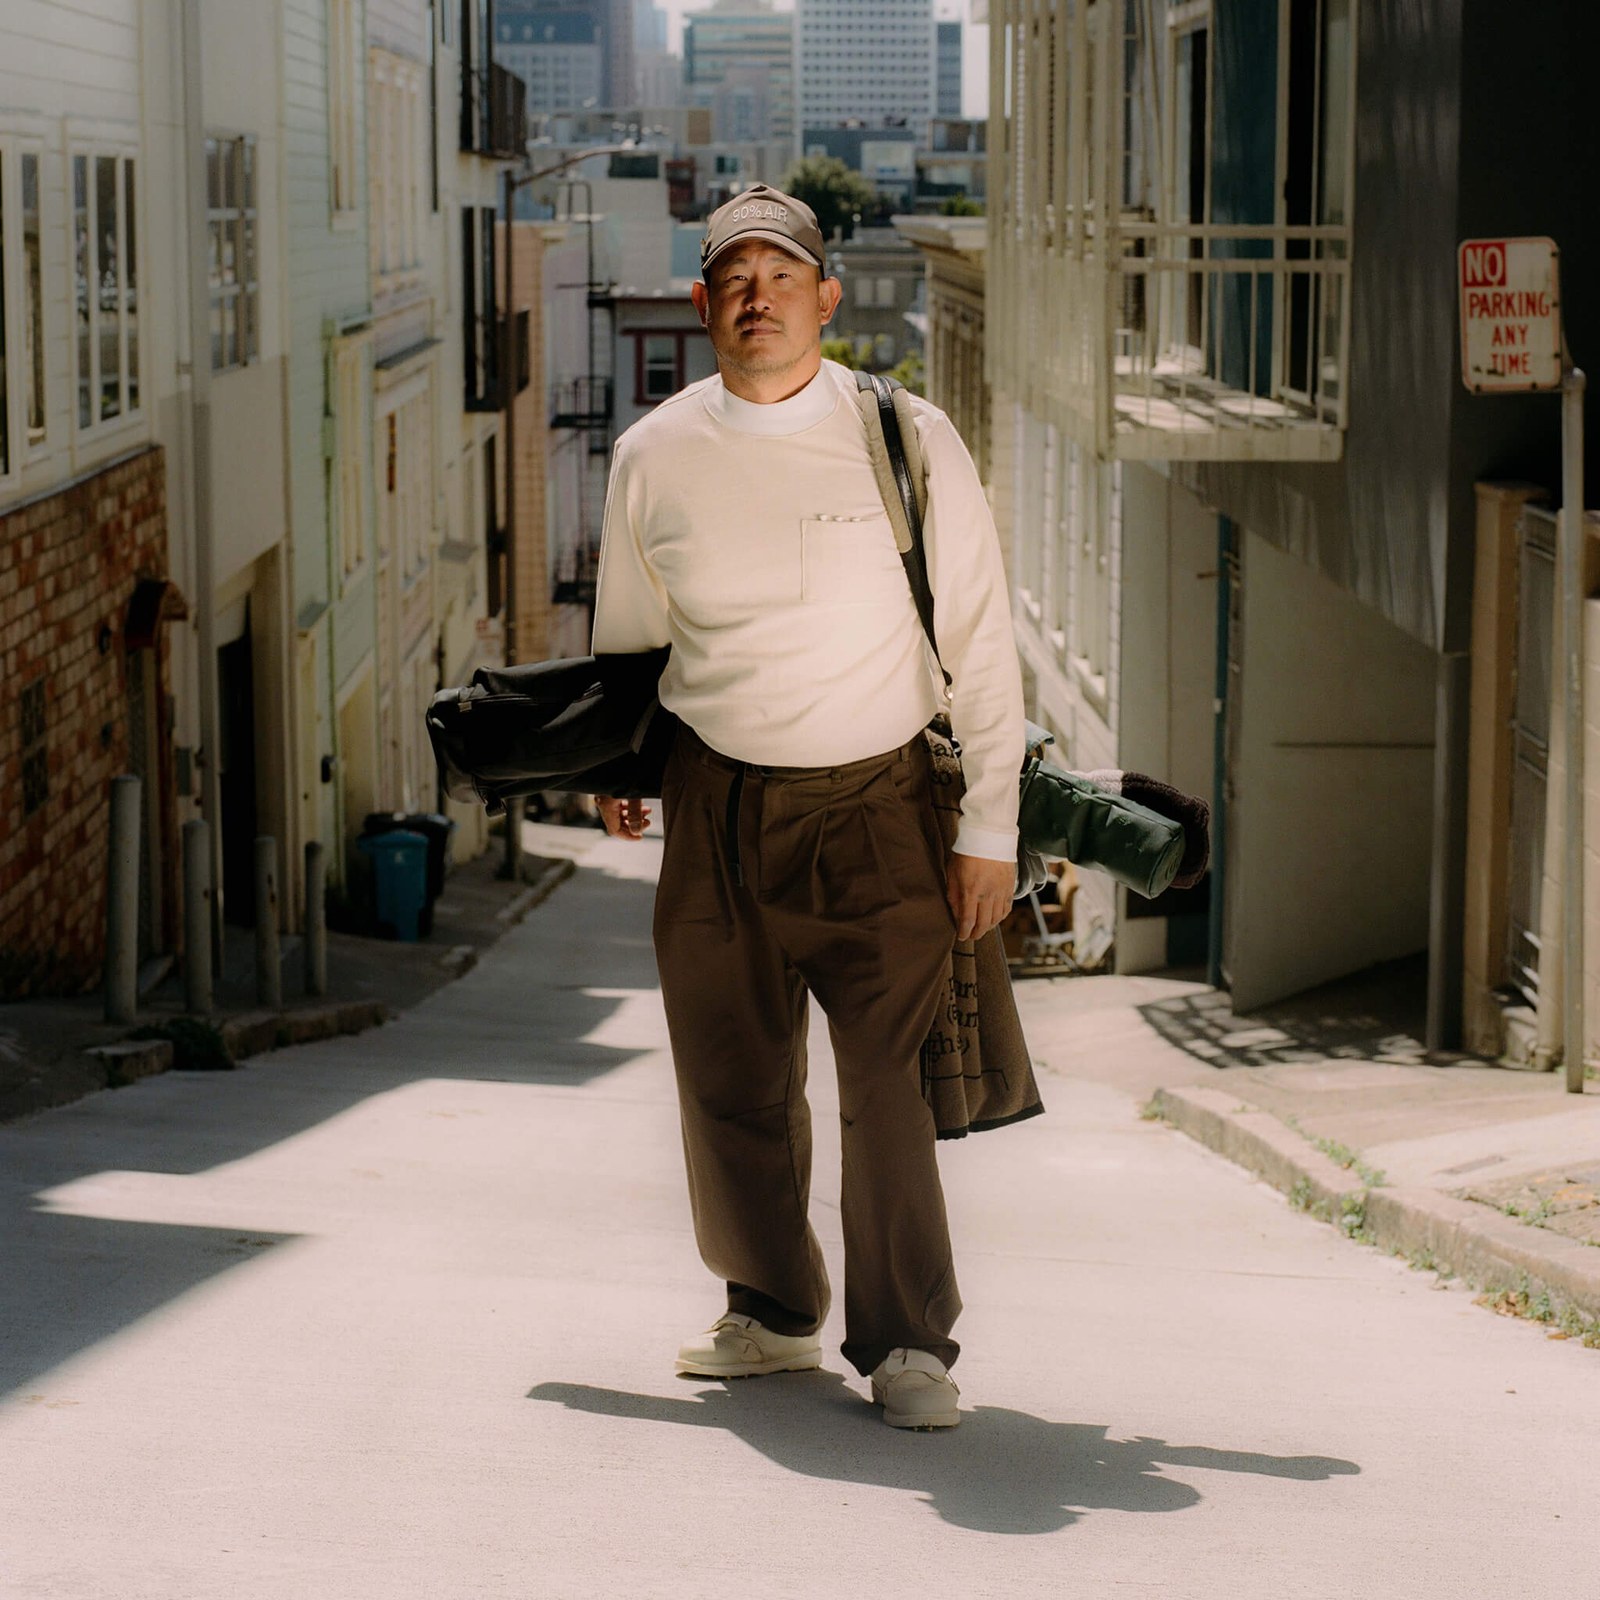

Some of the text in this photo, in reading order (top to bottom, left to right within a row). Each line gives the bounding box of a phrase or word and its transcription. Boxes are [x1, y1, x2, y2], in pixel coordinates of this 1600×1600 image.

[732, 204, 788, 222] 90% AIR
[1465, 246, 1503, 283] NO
[1468, 291, 1550, 319] PARKING
[1491, 324, 1529, 347] ANY
[1491, 352, 1531, 375] TIME
